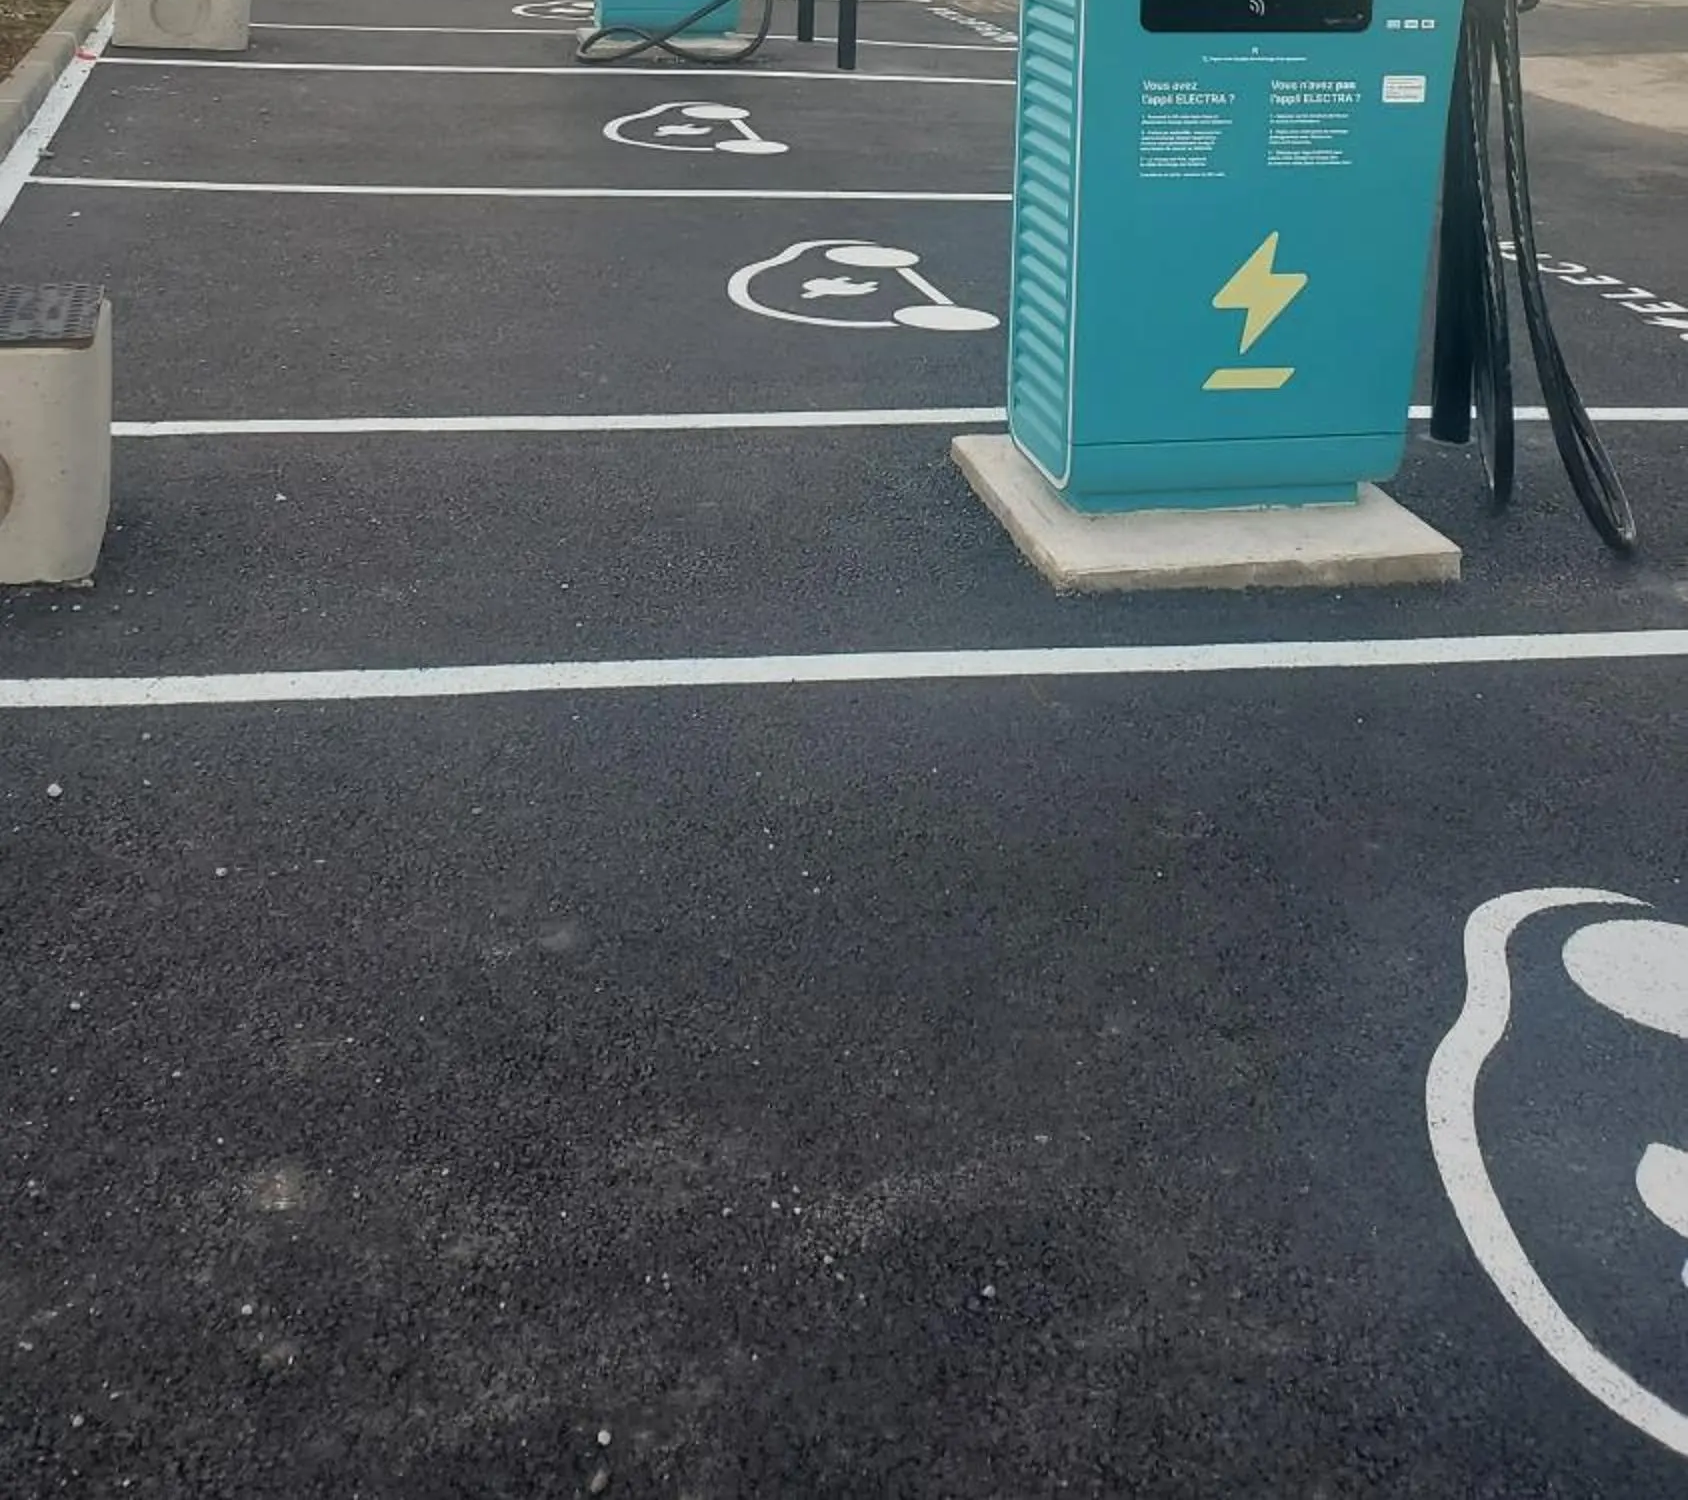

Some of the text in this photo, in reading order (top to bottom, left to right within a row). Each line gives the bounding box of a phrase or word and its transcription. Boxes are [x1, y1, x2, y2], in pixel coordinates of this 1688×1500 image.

[1143, 80, 1198, 91] Vous avez
[1271, 80, 1298, 91] Vous
[1335, 82, 1357, 92] pas
[1175, 93, 1227, 104] ELECTRA
[1303, 93, 1353, 104] ELECTRA
